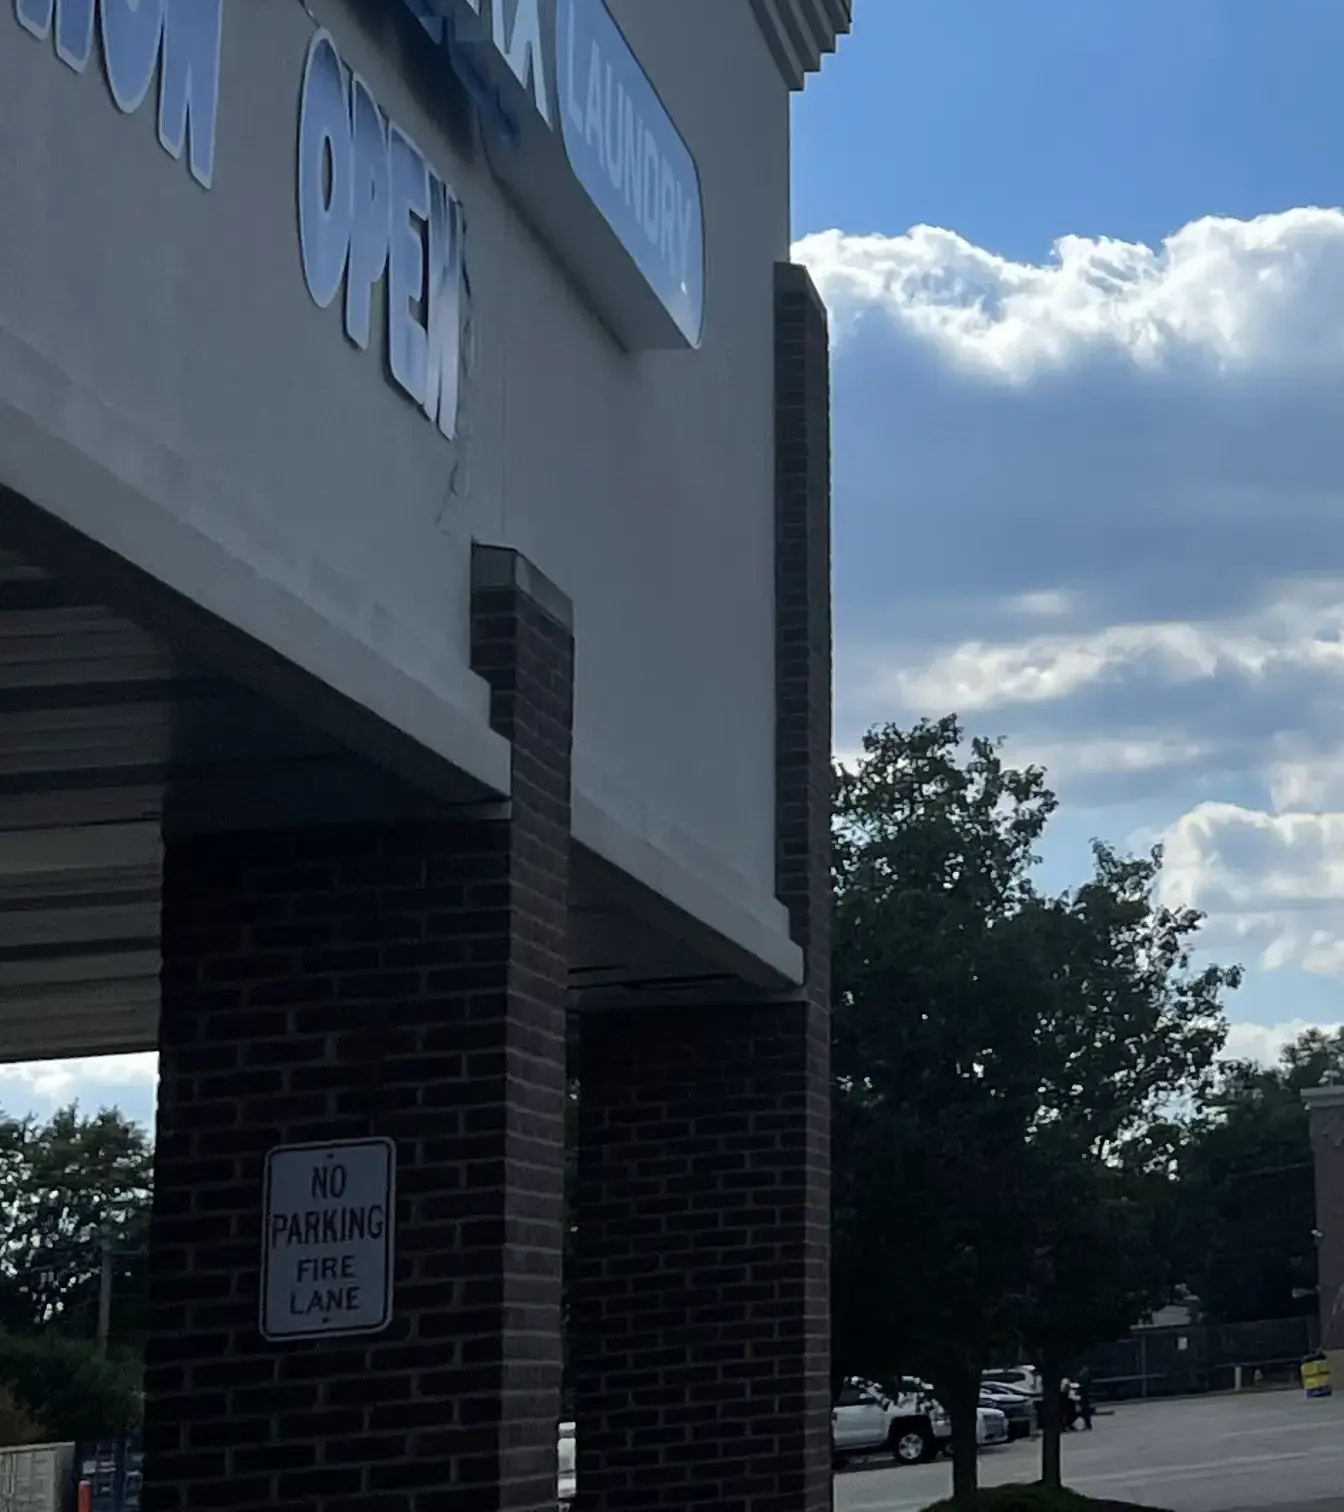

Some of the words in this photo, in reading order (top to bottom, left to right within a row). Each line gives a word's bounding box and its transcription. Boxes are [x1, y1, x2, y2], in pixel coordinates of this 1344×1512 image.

[299, 26, 459, 442] OPEN
[311, 1164, 347, 1200] NO
[272, 1204, 384, 1248] PARKING
[297, 1254, 359, 1283] FIRE
[289, 1286, 361, 1316] LANE
